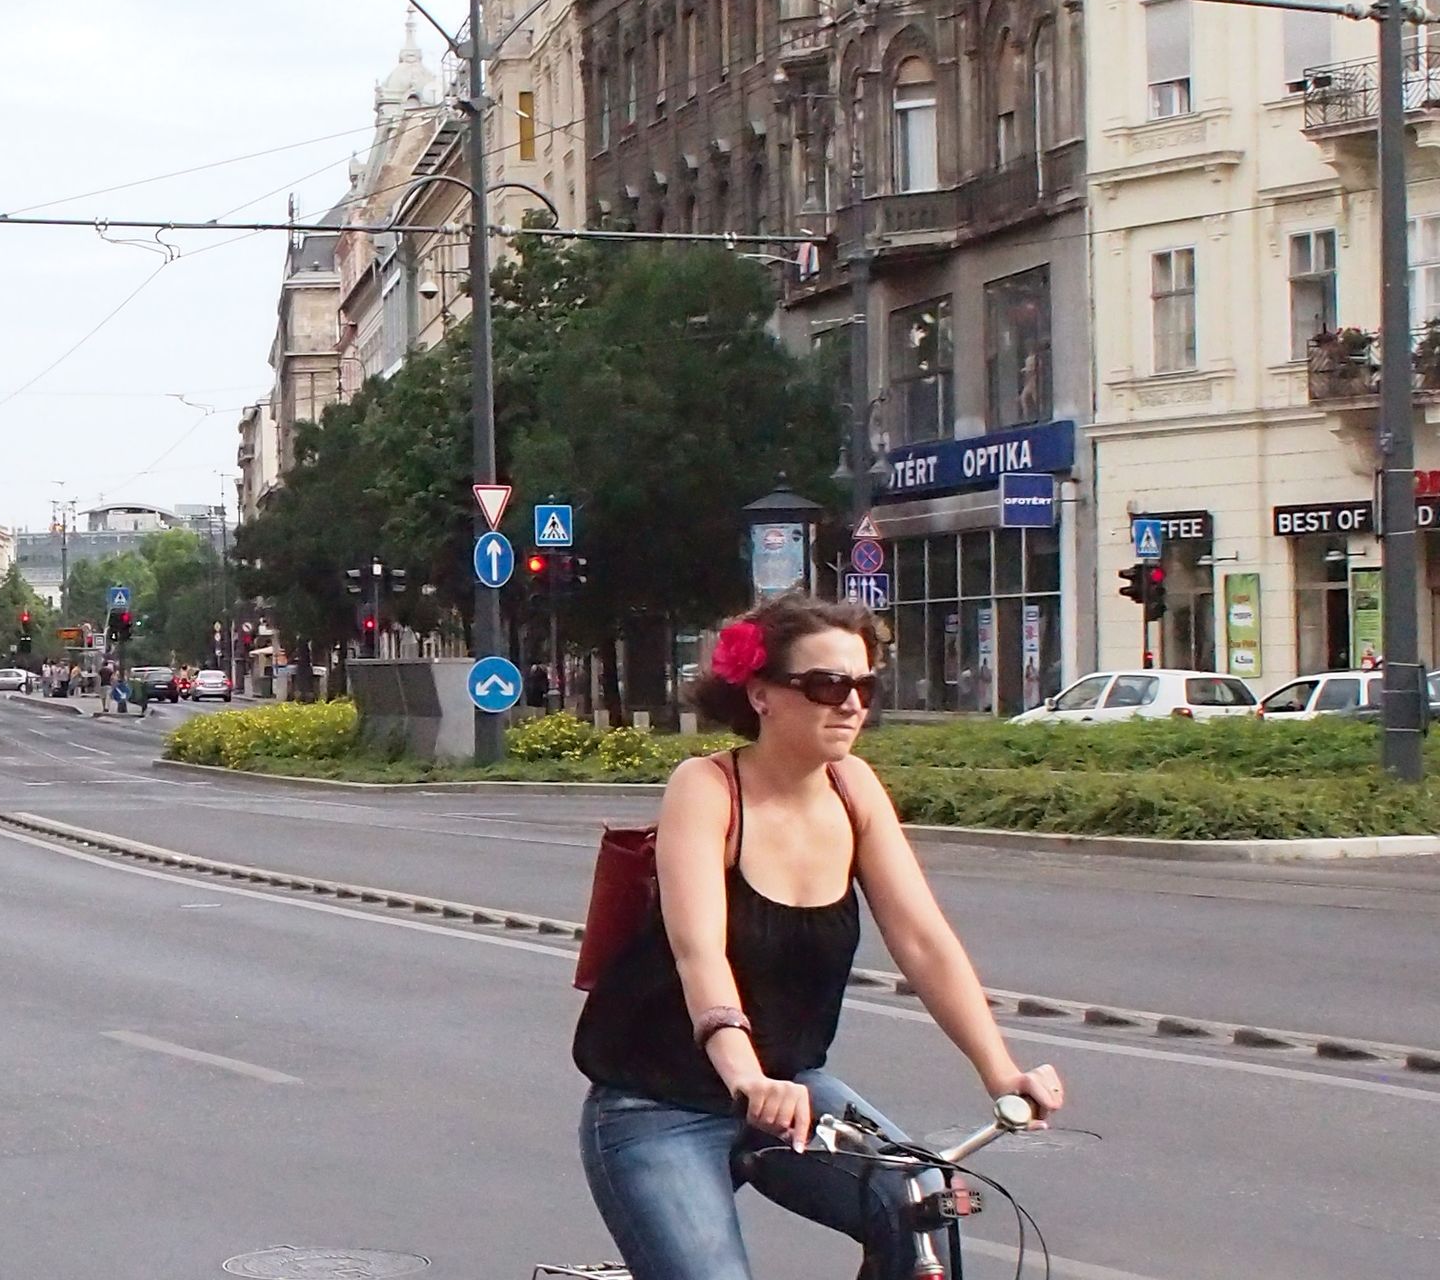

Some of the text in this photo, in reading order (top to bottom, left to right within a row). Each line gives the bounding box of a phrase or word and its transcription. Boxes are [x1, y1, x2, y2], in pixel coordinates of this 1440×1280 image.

[962, 439, 1032, 478] OPTIKA
[1004, 496, 1052, 506] OFOTÉRT
[1131, 518, 1204, 540] FFEE
[1278, 508, 1367, 533] BEST OF
